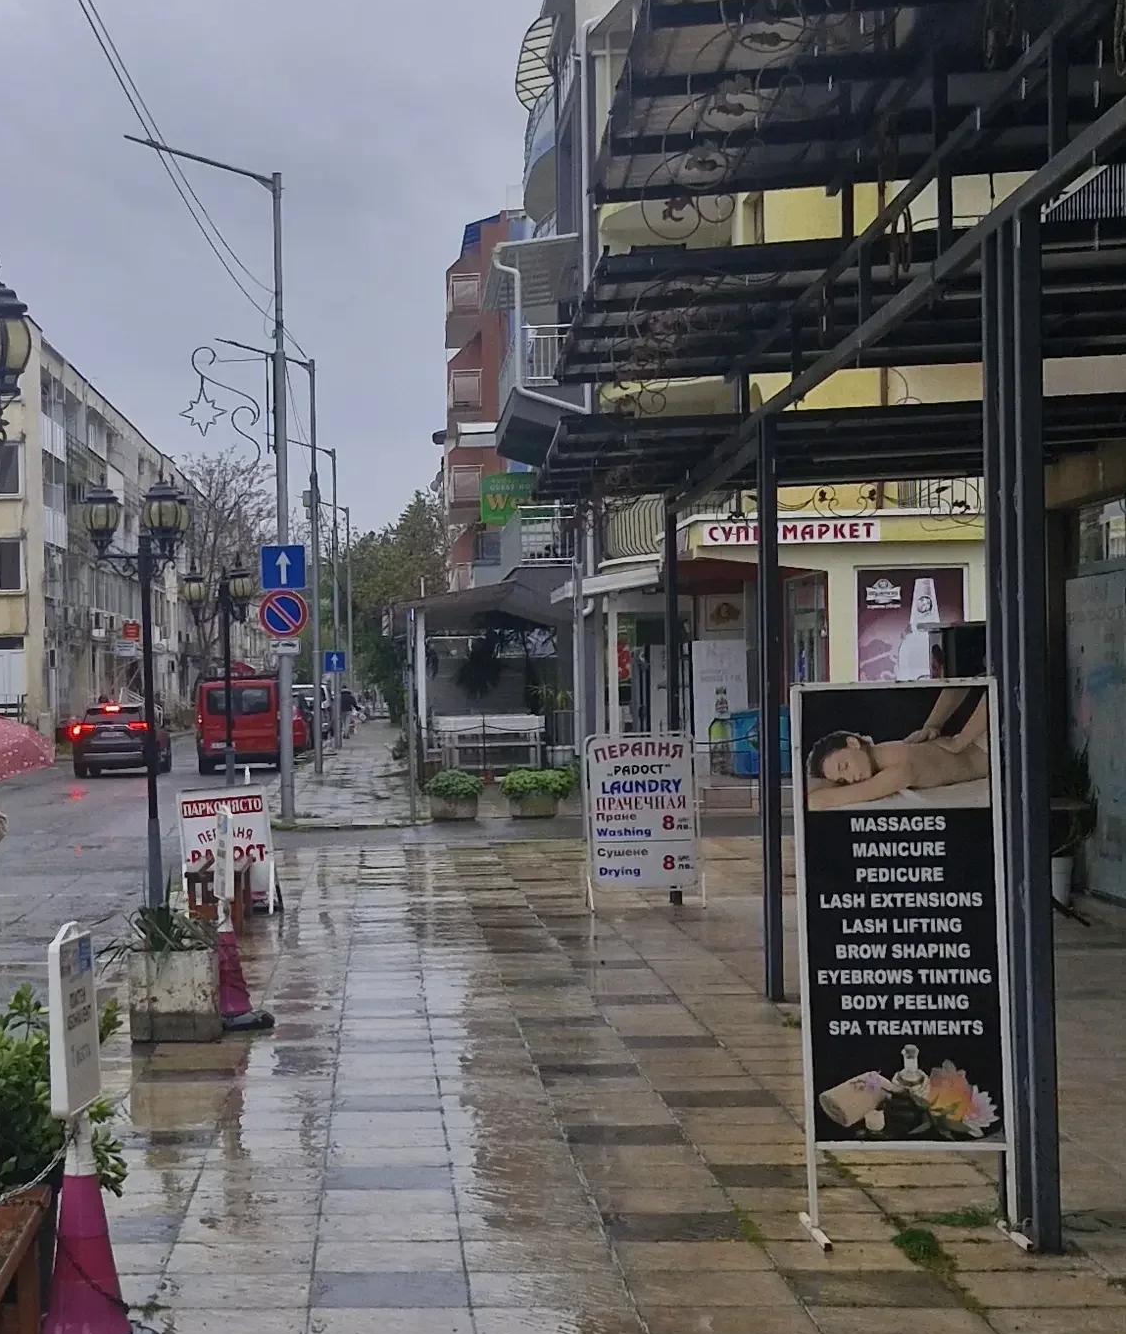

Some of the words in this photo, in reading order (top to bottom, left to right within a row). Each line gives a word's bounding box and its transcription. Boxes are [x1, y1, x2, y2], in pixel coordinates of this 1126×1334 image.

[708, 522, 875, 543] СУПМАРКЕТ
[601, 778, 682, 795] LAUNDRY
[596, 795, 687, 812] ПРАЧЕЧНАЯ
[596, 813, 637, 823] Пране
[662, 814, 675, 830] 8
[851, 816, 946, 832] MASSAGES
[597, 827, 652, 838] Washing
[191, 844, 266, 864] РАОСТ
[852, 841, 946, 858] MANICURE
[597, 847, 649, 859] Сушене
[663, 854, 675, 871] 8
[599, 866, 641, 878] Drying
[856, 867, 944, 883] PEDICURE
[820, 893, 865, 909] LASH
[870, 892, 983, 908] EXTENSIONS
[842, 918, 888, 934] LASH
[892, 918, 962, 934] LIFTING
[835, 944, 887, 960] BROW
[891, 943, 971, 959] SHAPING
[817, 969, 914, 985] EYEBROWS
[917, 969, 992, 984] TINTING
[841, 995, 888, 1010] BODY
[893, 994, 969, 1010] PEELING
[828, 1020, 862, 1036] SPA
[866, 1020, 984, 1036] TREATMENTS
